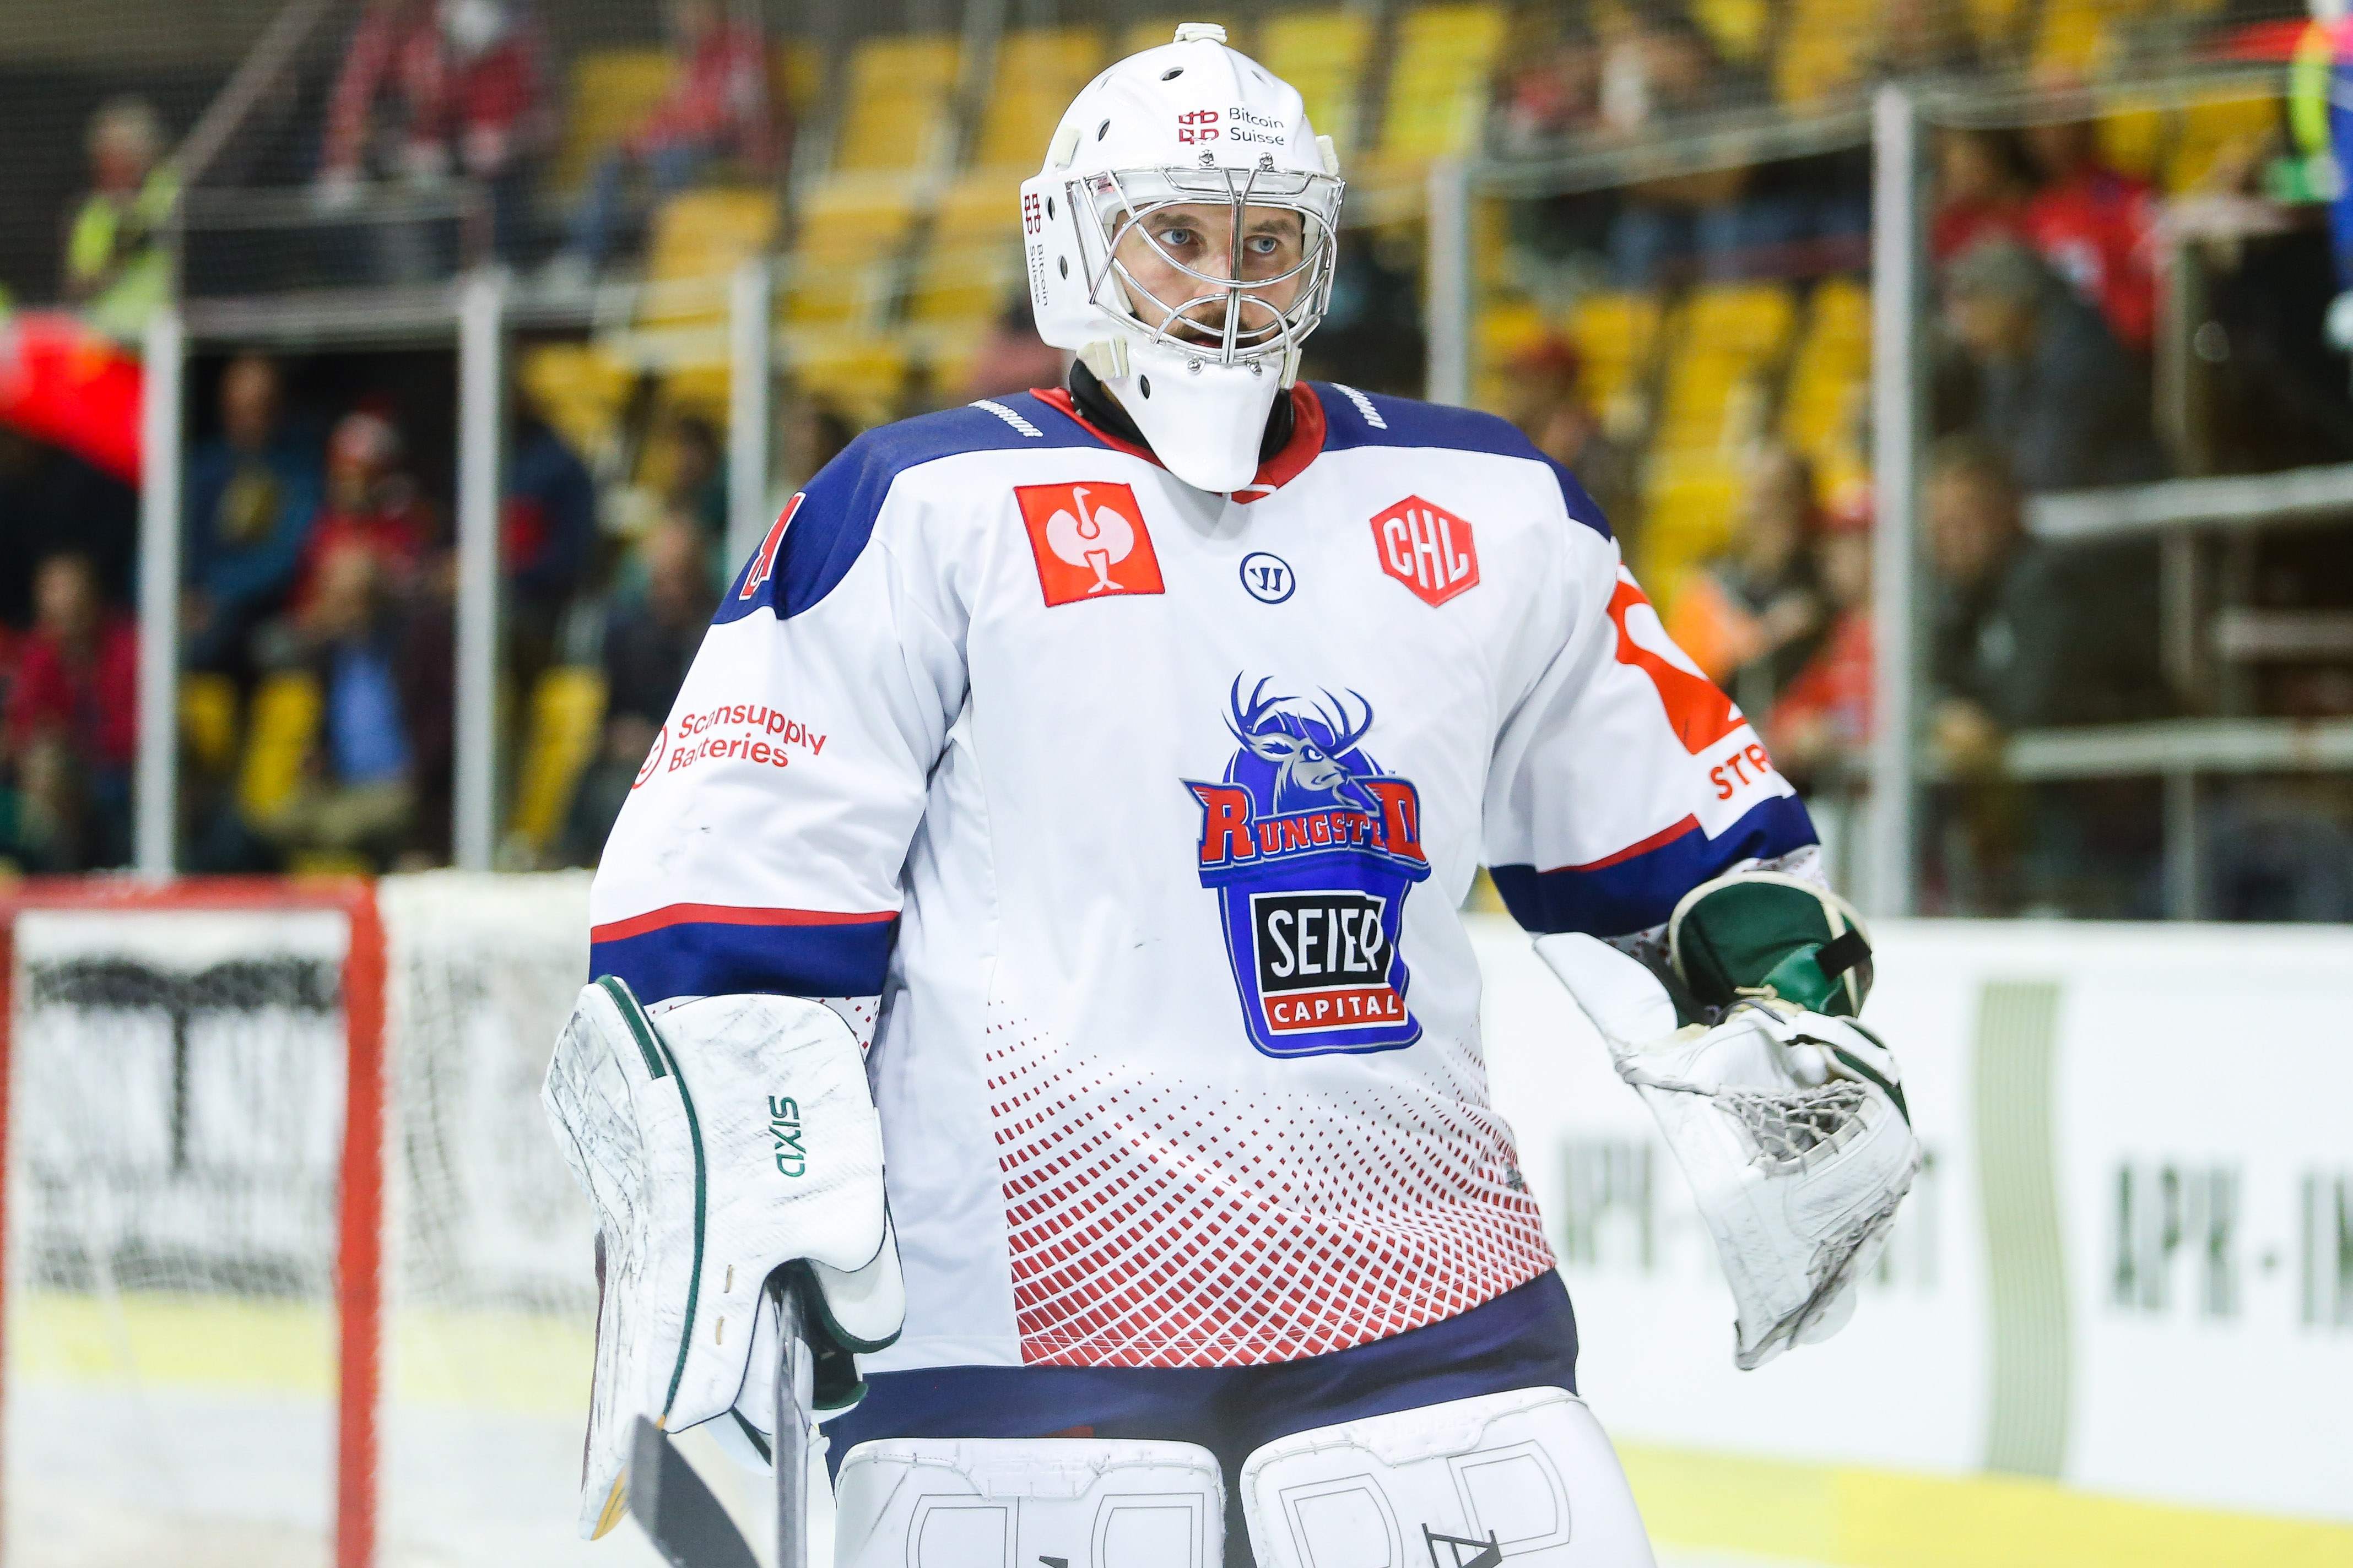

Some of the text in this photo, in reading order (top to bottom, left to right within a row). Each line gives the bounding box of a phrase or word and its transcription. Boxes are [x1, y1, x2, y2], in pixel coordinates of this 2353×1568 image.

[1229, 107, 1284, 128] Bitcoin
[1230, 127, 1285, 145] Suisse
[1030, 244, 1040, 304] Suisse
[1037, 243, 1048, 306] Bitcoin
[1383, 508, 1469, 590] CHL
[678, 704, 827, 756] Scansupply
[1192, 781, 1429, 865] RUNGSTD
[1268, 908, 1384, 978] SEIER
[1274, 994, 1399, 1023] CAPITAL
[768, 1095, 807, 1178] SIXD
